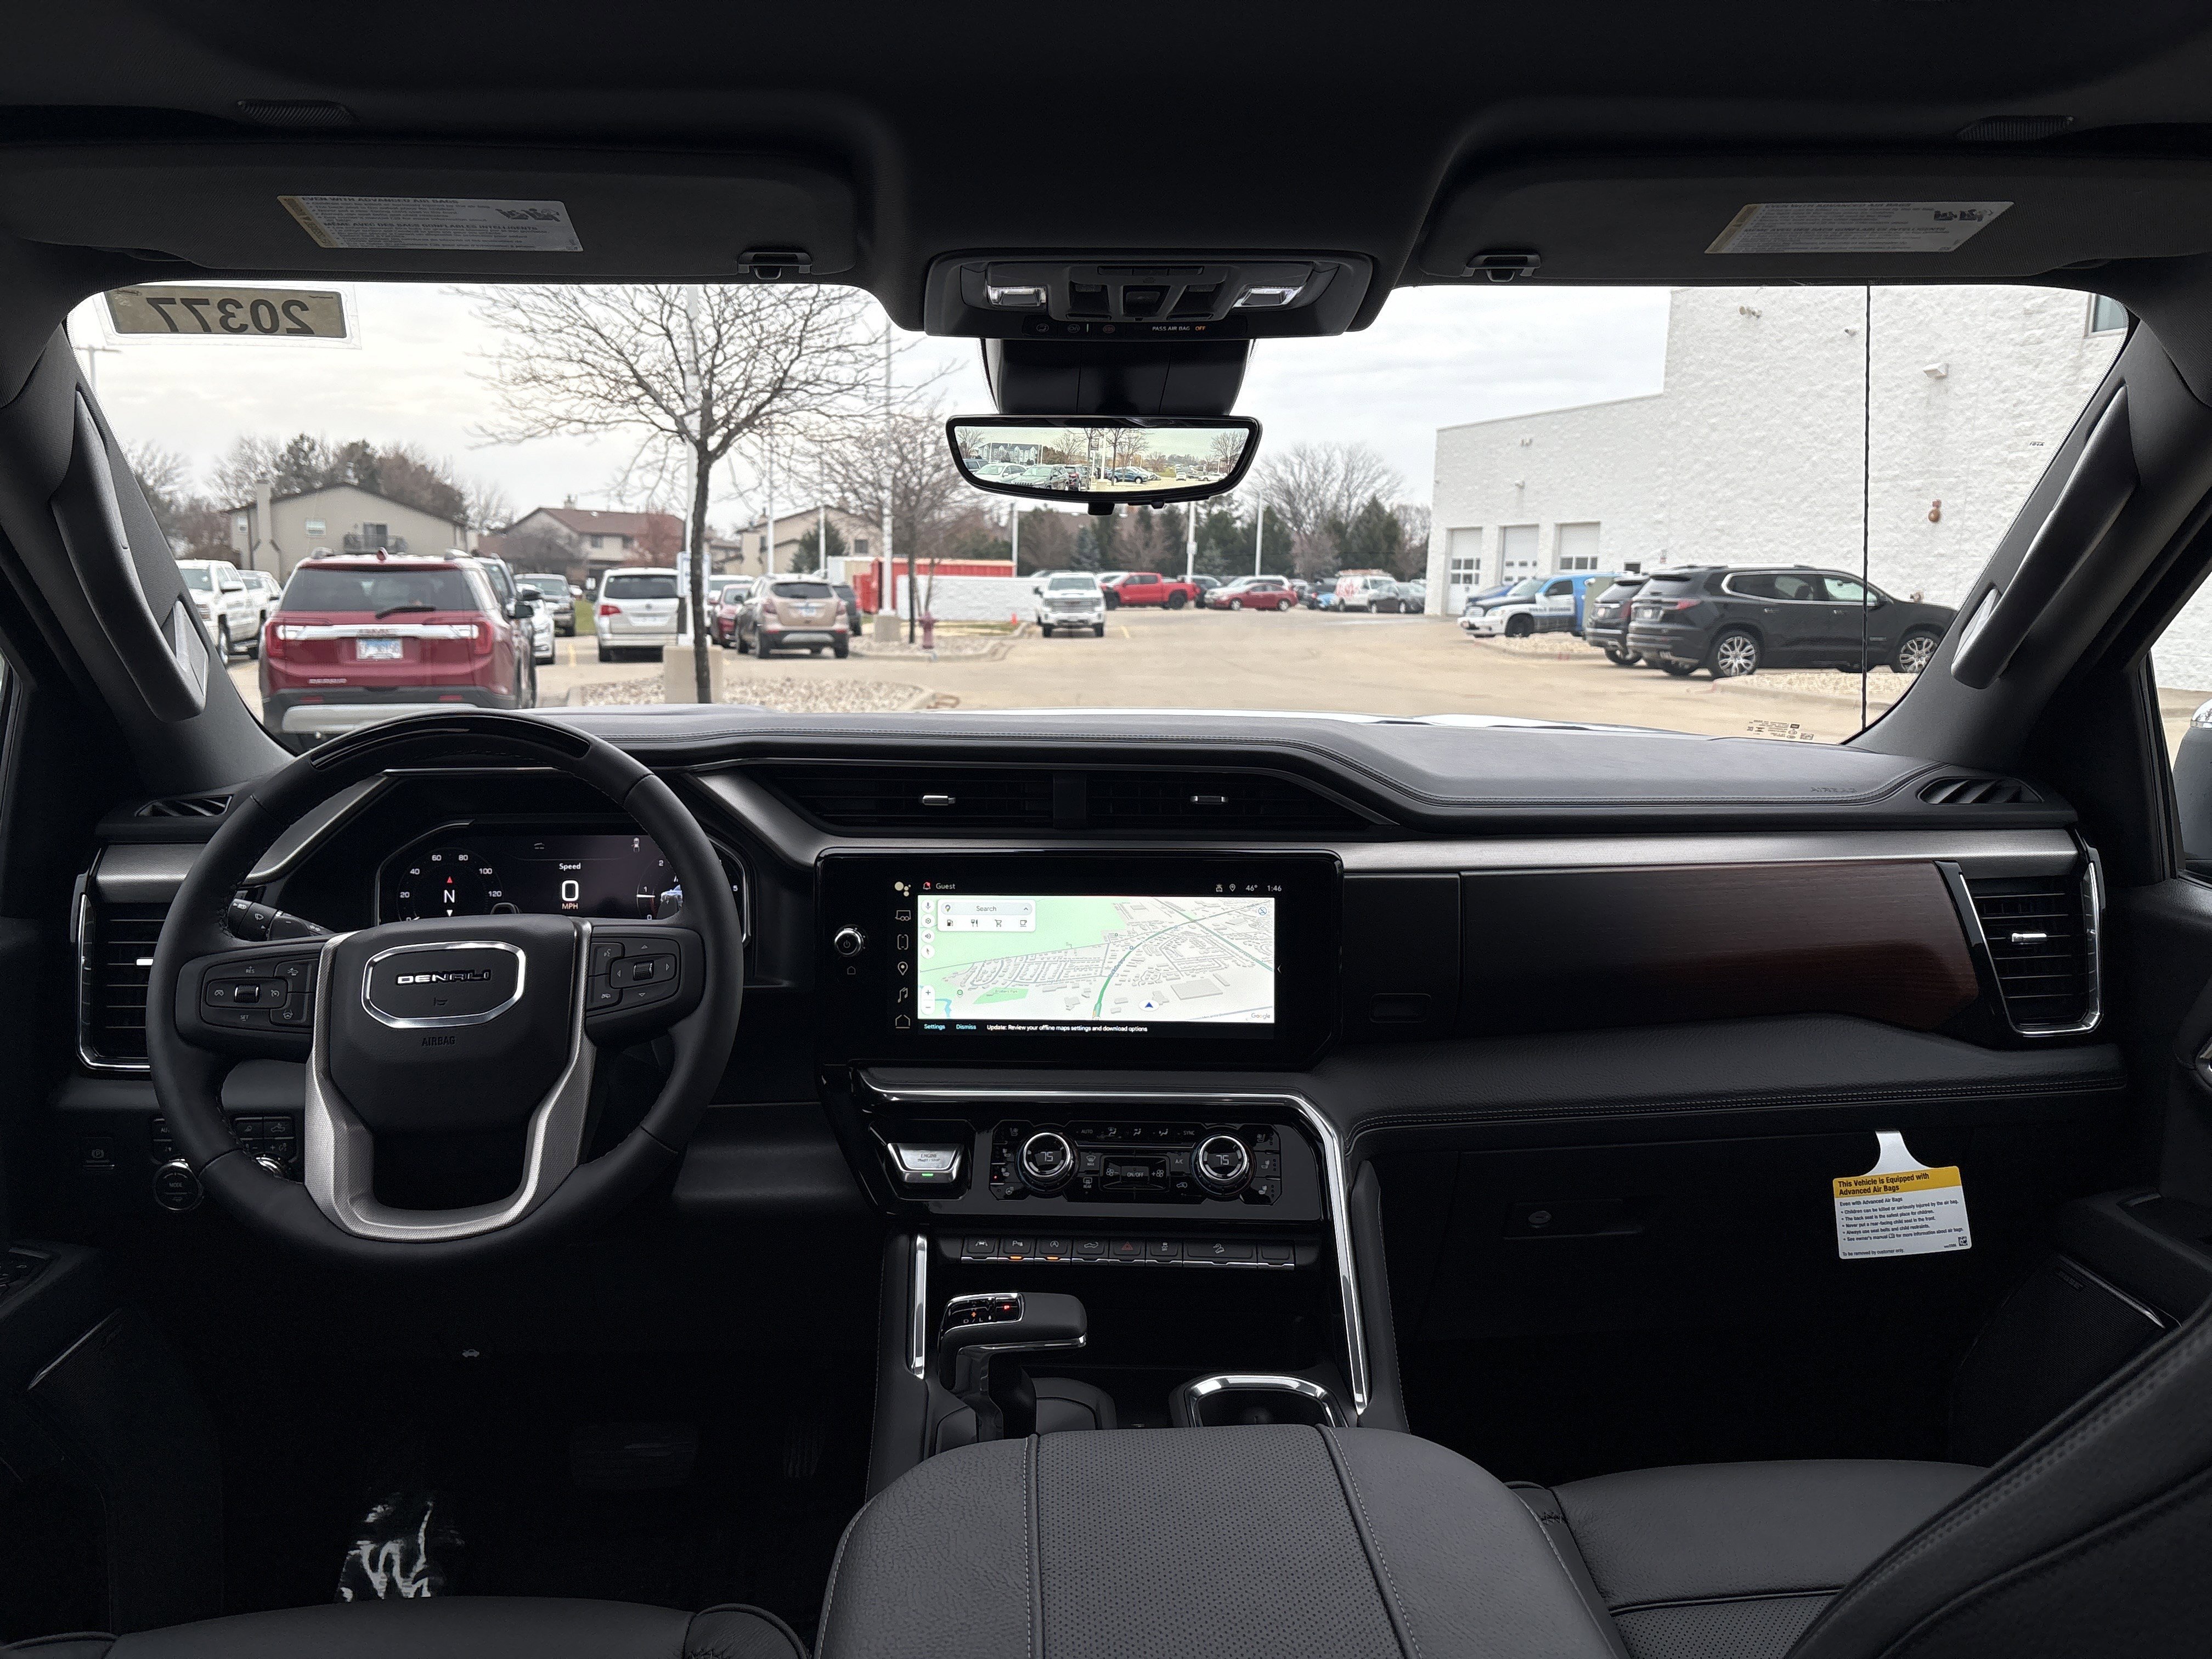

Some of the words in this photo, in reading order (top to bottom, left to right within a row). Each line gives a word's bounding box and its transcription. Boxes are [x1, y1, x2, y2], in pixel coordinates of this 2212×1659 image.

[558, 862, 581, 871] Speed
[443, 889, 455, 903] N
[562, 880, 579, 901] 0
[398, 972, 489, 984] DENALI
[421, 1035, 455, 1046] AIRBAG
[1040, 1151, 1054, 1162] 75
[1215, 1154, 1229, 1165] 75
[1854, 1178, 1877, 1187] Vehicle
[1886, 1174, 1915, 1184] Equipped
[1839, 1187, 1871, 1195] Advanced
